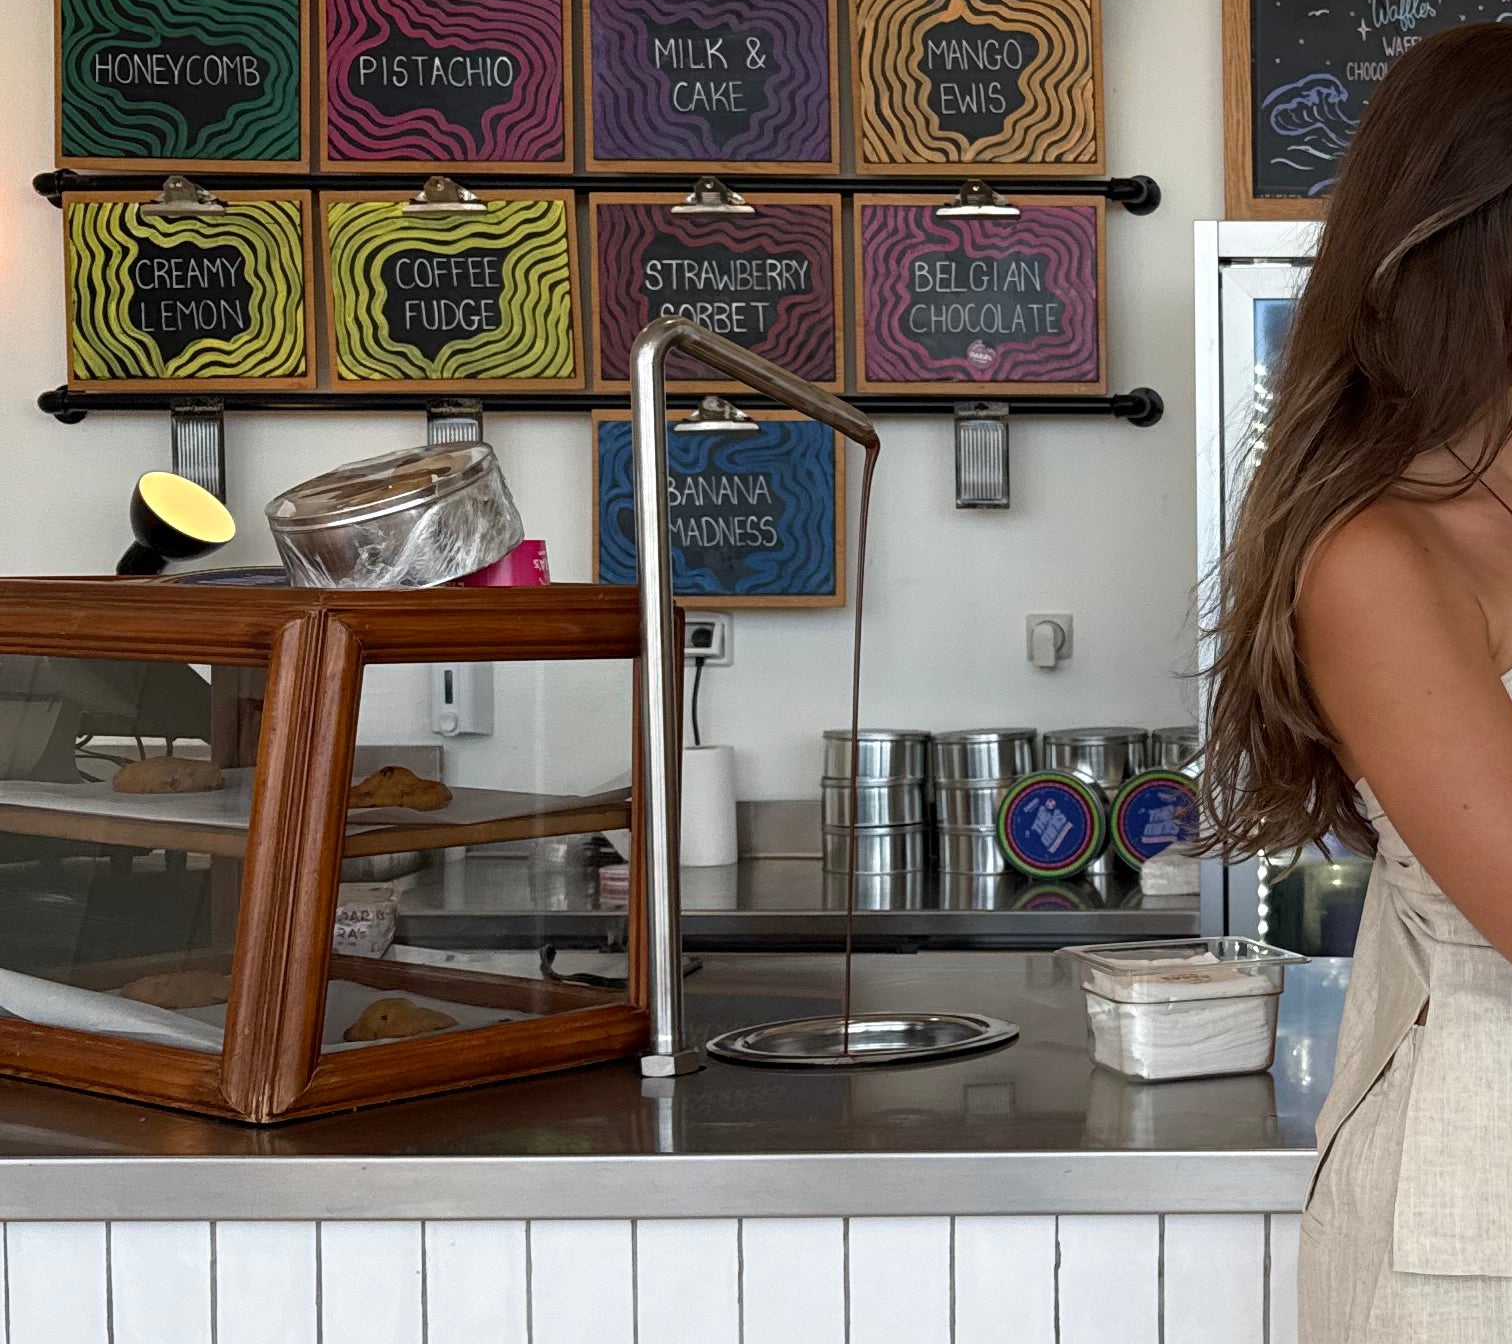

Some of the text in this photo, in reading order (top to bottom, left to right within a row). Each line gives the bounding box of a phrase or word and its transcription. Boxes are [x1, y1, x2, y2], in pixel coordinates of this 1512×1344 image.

[653, 36, 768, 70] MILK &
[927, 38, 1024, 71] MANGO
[1381, 36, 1423, 57] WAFF
[94, 53, 261, 87] HONEYCOMB
[358, 55, 515, 88] PISTACHIO
[1346, 61, 1389, 81] CHOCO
[673, 80, 749, 113] CAKE
[939, 82, 1007, 115] EWIS
[135, 256, 243, 290] CREAMY
[395, 256, 501, 289] COFFEE
[644, 258, 811, 293] STRAWBERRY
[914, 260, 1042, 293] BELGIAN
[141, 299, 246, 333] LEMON
[404, 298, 499, 331] FUDGE
[908, 302, 1060, 335] CHOCOLATE
[666, 475, 773, 507] BANANA
[668, 515, 778, 548] MADNESS
